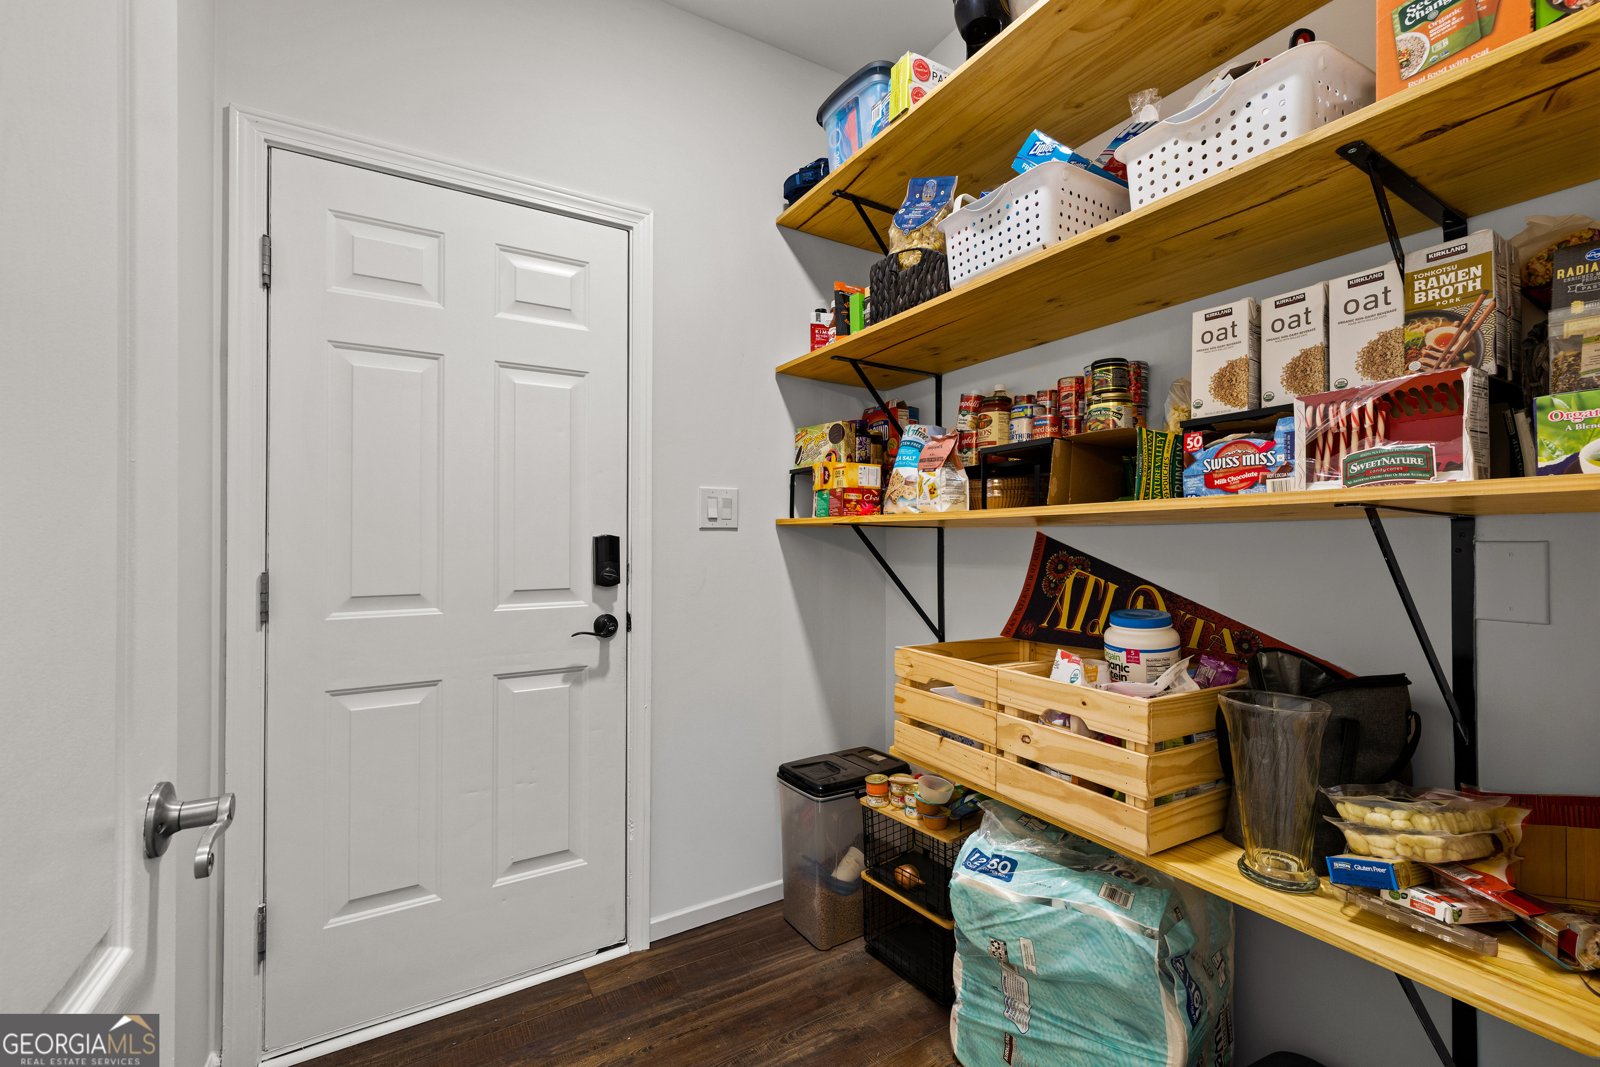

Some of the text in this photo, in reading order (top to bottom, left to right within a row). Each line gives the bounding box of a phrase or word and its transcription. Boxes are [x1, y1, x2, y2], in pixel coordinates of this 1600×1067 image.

[1029, 141, 1055, 155] Ziploc
[1428, 244, 1467, 259] KIRKLAND
[1349, 272, 1384, 286] KIRKLAND
[1413, 264, 1458, 280] TONKOTSU
[1413, 264, 1483, 292] RAMEN
[1413, 277, 1482, 305] BROTH
[1276, 293, 1305, 306] KIRKLAND
[1343, 286, 1392, 315] oat
[1436, 296, 1461, 306] PORK
[1205, 308, 1232, 319] KIRKLAND
[1271, 307, 1312, 333] oat
[1201, 320, 1238, 345] oat
[1155, 434, 1166, 466] VALLEY
[1186, 436, 1203, 449] 50
[1203, 450, 1276, 473] SWISS MISS
[1214, 471, 1258, 486] Milk Chocolate
[1039, 568, 1237, 655] ATLATA
